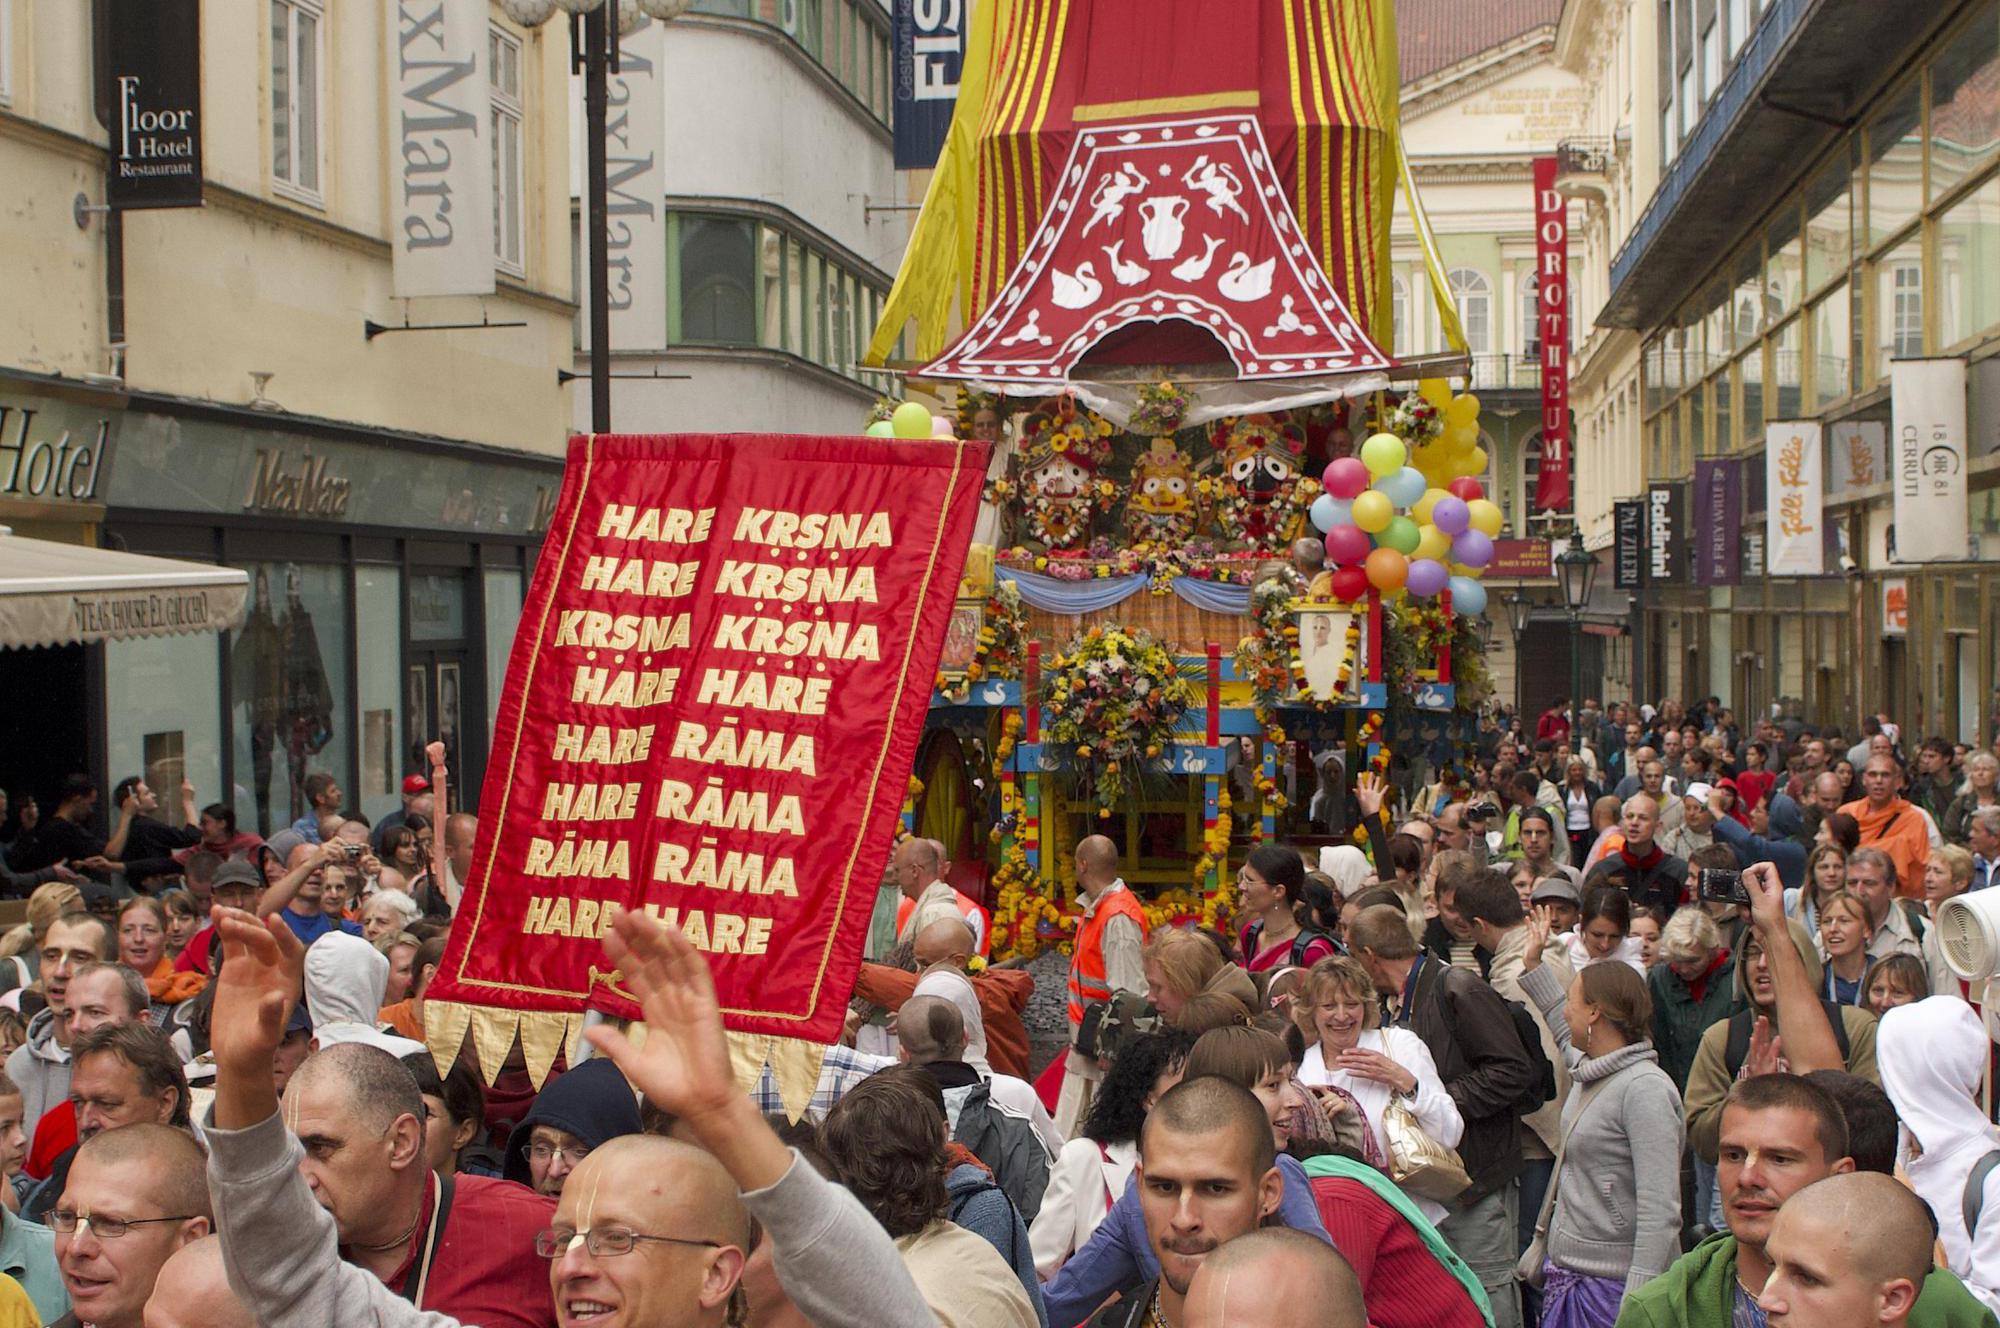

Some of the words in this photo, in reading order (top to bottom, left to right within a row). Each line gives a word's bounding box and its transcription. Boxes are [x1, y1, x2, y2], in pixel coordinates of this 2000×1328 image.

[118, 76, 193, 159] Floor
[139, 136, 193, 158] Hotel
[119, 161, 193, 177] Restaurant
[1540, 190, 1564, 461] DOROTHEUM
[0, 406, 109, 499] Hotel
[1778, 436, 1808, 486] Follie
[1902, 425, 1918, 497] CERRUTI
[597, 504, 716, 545] HARE
[1621, 507, 1637, 531] PAL
[1651, 490, 1671, 577] Baldinini
[1780, 494, 1813, 537] Folli
[1621, 535, 1637, 584] ZILERI
[1712, 525, 1725, 561] FREY
[580, 556, 700, 598] HARE
[112, 599, 148, 630] HOUSE
[167, 592, 208, 626] GAUCHO
[572, 666, 680, 708] HARE
[697, 668, 832, 715] HARE
[552, 723, 656, 765] HARE
[541, 782, 641, 821] HARE
[523, 896, 622, 939] HARE
